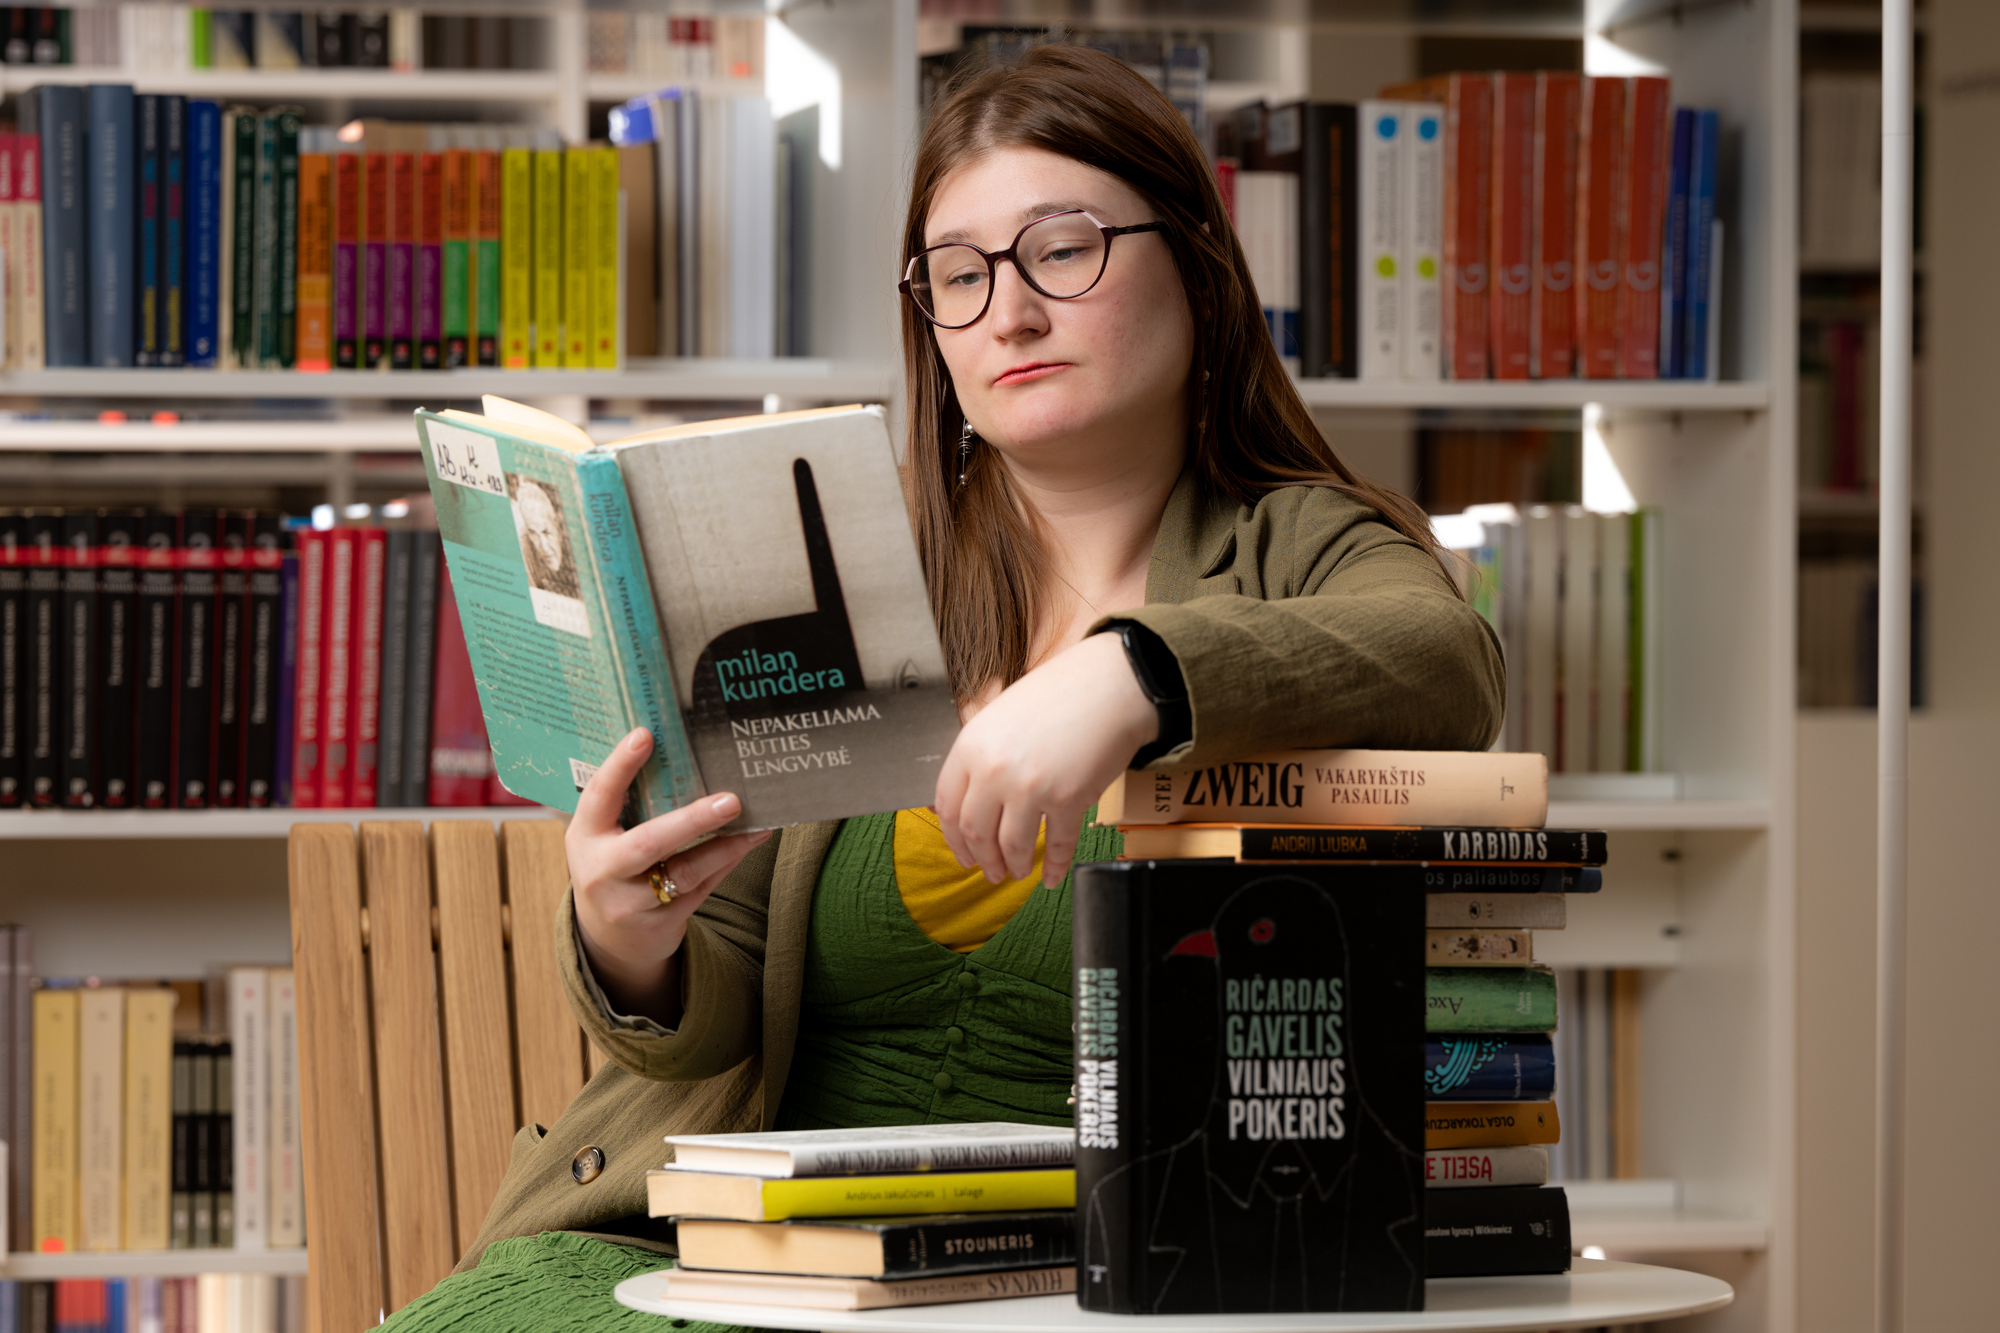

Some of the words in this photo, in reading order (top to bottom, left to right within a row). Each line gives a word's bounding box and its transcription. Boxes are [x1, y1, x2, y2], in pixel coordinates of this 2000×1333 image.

[588, 493, 613, 562] kundera
[602, 492, 622, 538] milan
[715, 648, 798, 678] milan
[720, 667, 845, 702] kundera
[730, 704, 882, 738] NEPAKELIAMA
[735, 733, 811, 758] BŪTIES
[740, 745, 852, 778] LENGVYBĖ
[1154, 772, 1172, 813] STEF
[1182, 762, 1304, 808] ZWEIG
[1315, 766, 1426, 786] VAKARYKŠTIS
[1331, 788, 1410, 805] PASAULIS
[1320, 836, 1368, 853] LIUBKA
[1443, 831, 1548, 860] KARBIDAS
[1425, 871, 1446, 885] os
[1453, 869, 1541, 889] paliaubos
[1226, 973, 1343, 1012] RIČARDAS
[1077, 967, 1099, 1057] GAVELIS
[1226, 1013, 1343, 1058] GAVELIS
[1227, 1058, 1346, 1096] VILNIAUS
[1078, 1059, 1100, 1149] POKERIS
[1098, 1059, 1119, 1150] VILNIAUS
[1228, 1097, 1346, 1141] POKERIS
[1486, 1116, 1515, 1127] OLGA
[815, 1149, 875, 1173] SIGMUND
[876, 1148, 920, 1170] FREUD
[931, 1145, 1007, 1168] NERIMASTIS
[1008, 1141, 1076, 1165] KULTŪROJ
[1425, 1157, 1437, 1180] E
[945, 1233, 1034, 1255] STOUNERIS
